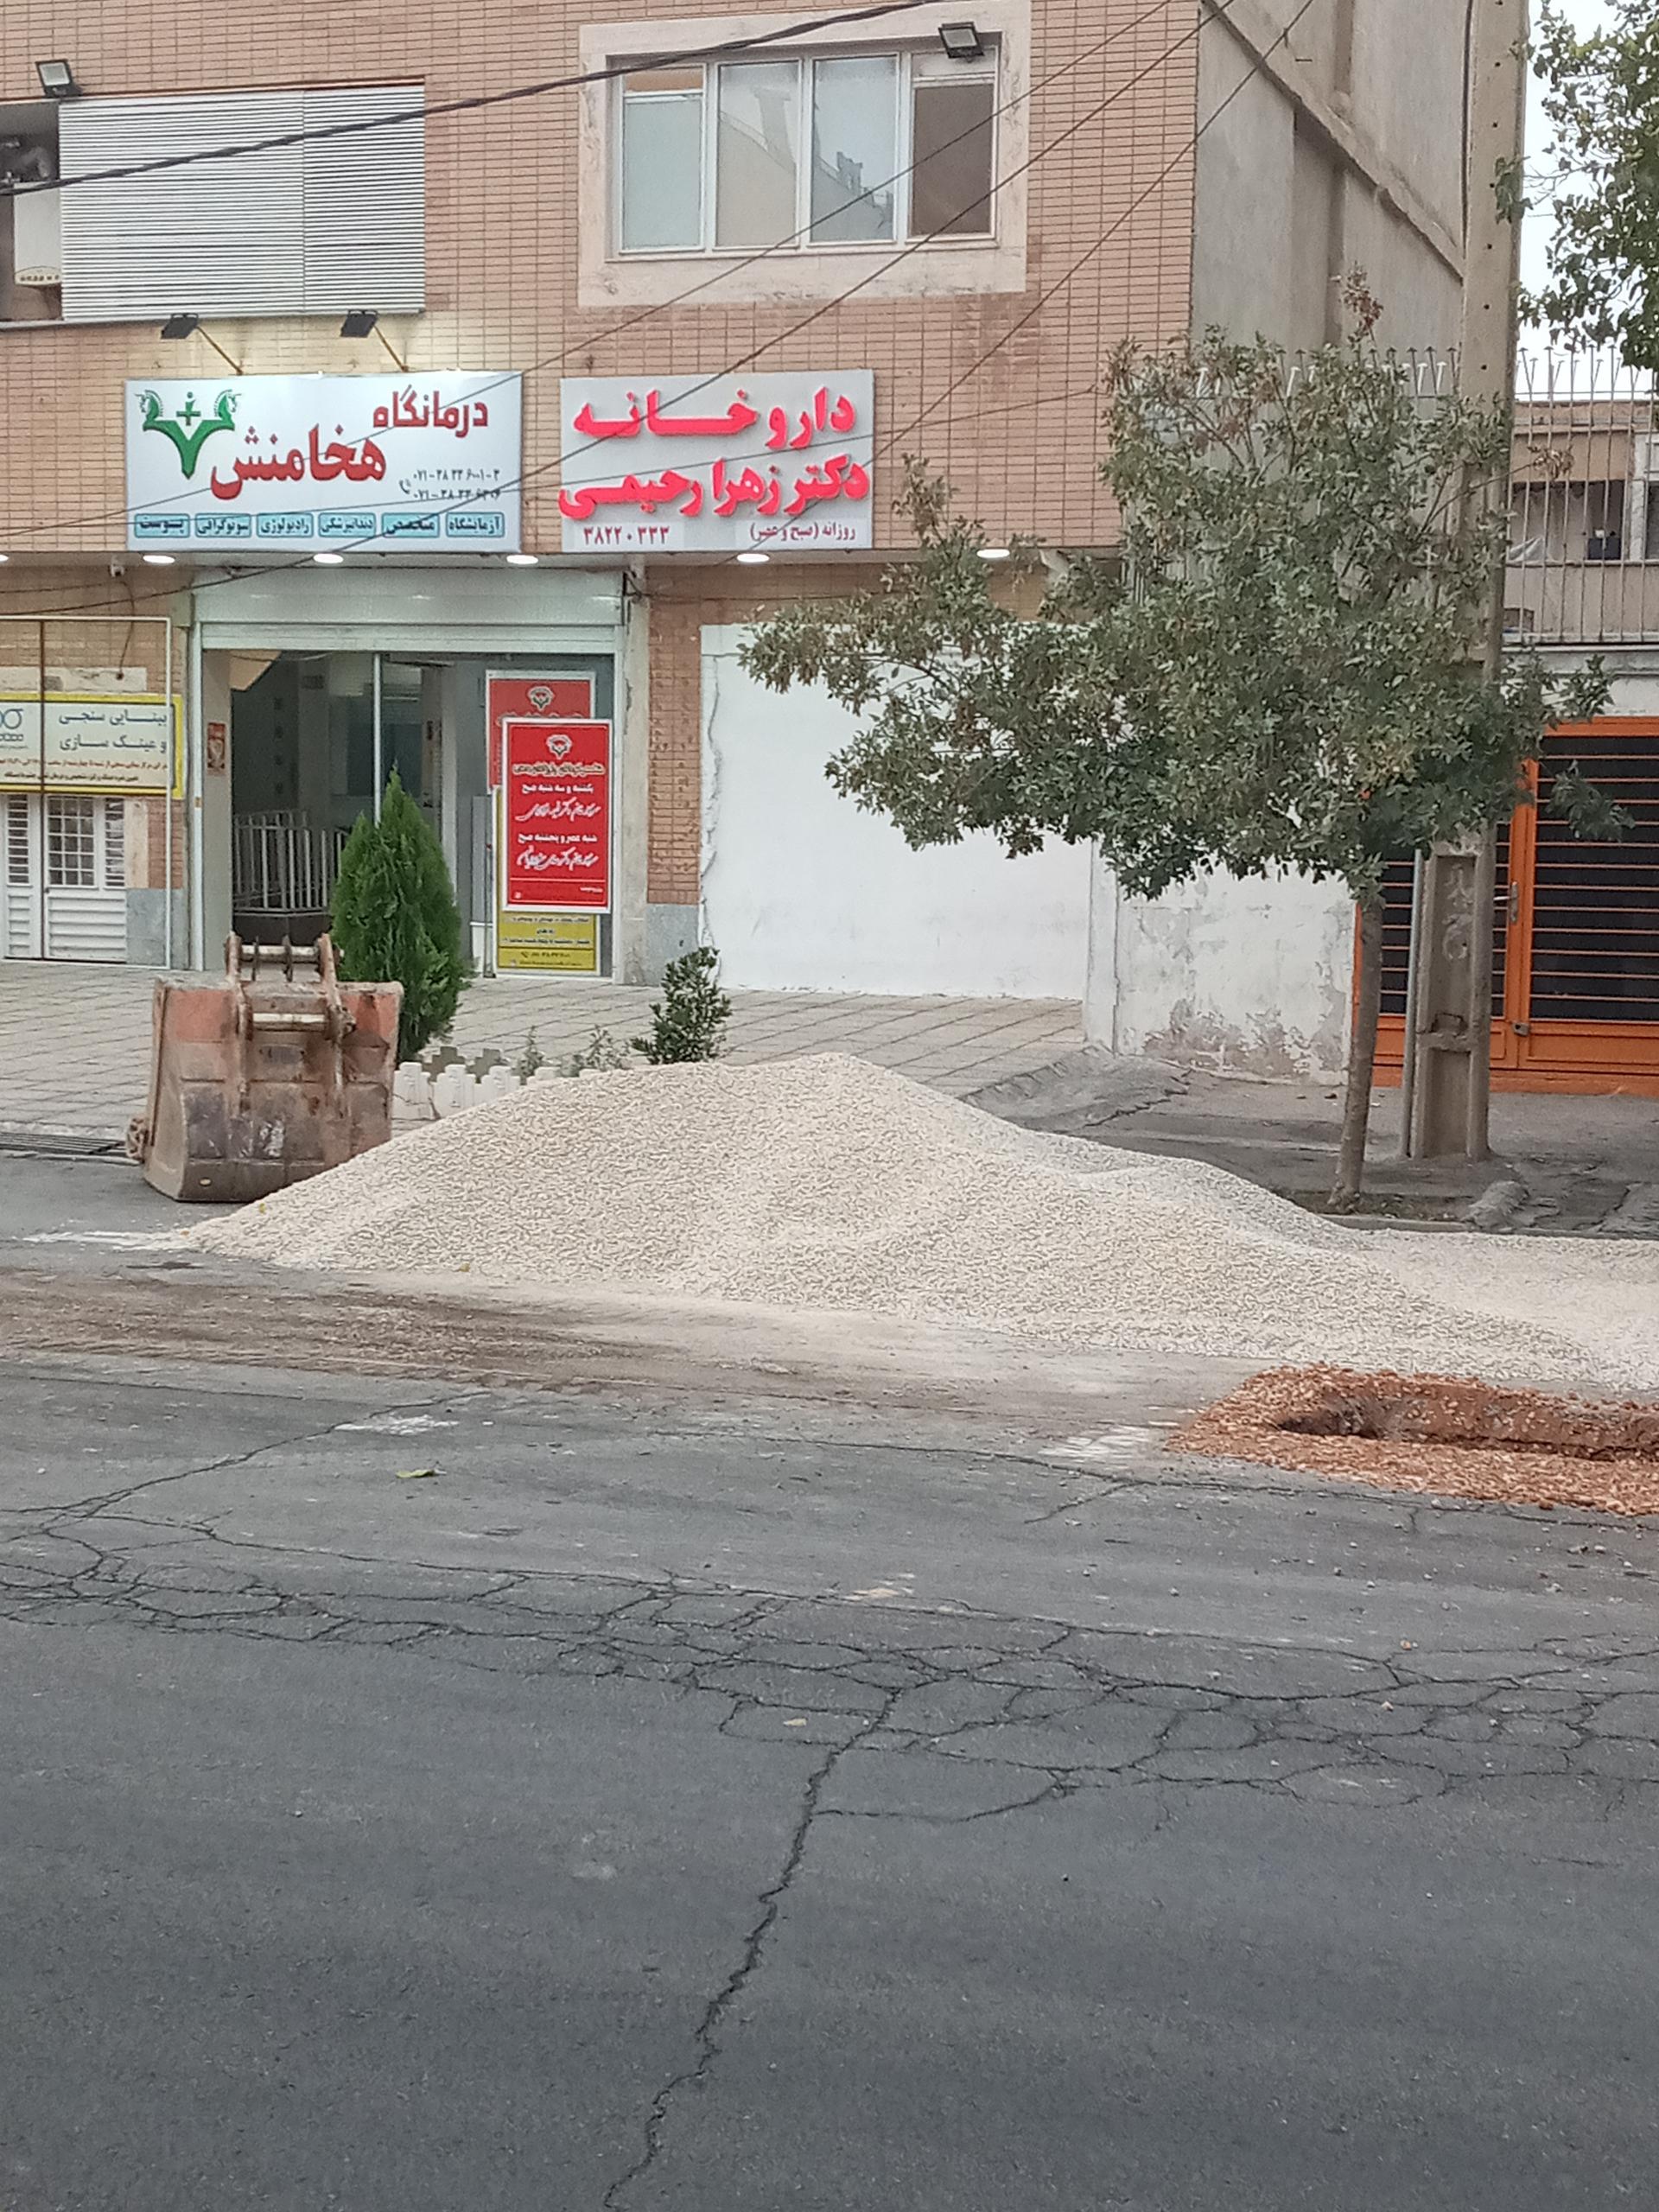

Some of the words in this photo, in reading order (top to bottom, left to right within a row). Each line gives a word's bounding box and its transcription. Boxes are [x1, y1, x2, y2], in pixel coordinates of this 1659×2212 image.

[373, 384, 489, 438] درمانگاه
[573, 386, 856, 449] داروخانه
[210, 423, 386, 501] هخامنش
[557, 469, 704, 520] رحیمی
[714, 457, 782, 517] زهرا
[783, 454, 870, 516] دکتر
[197, 517, 251, 536] سونوگرافی
[260, 517, 310, 535] رادیولوژی
[385, 518, 435, 535] متخصص
[448, 516, 501, 535] آزمایشگاه
[822, 522, 856, 541] روزانه
[781, 530, 788, 541] و
[59, 711, 105, 725] سنجی
[109, 709, 167, 726] بینایی
[60, 734, 110, 750] سازی
[112, 734, 157, 752] عینک
[160, 740, 167, 753] و
